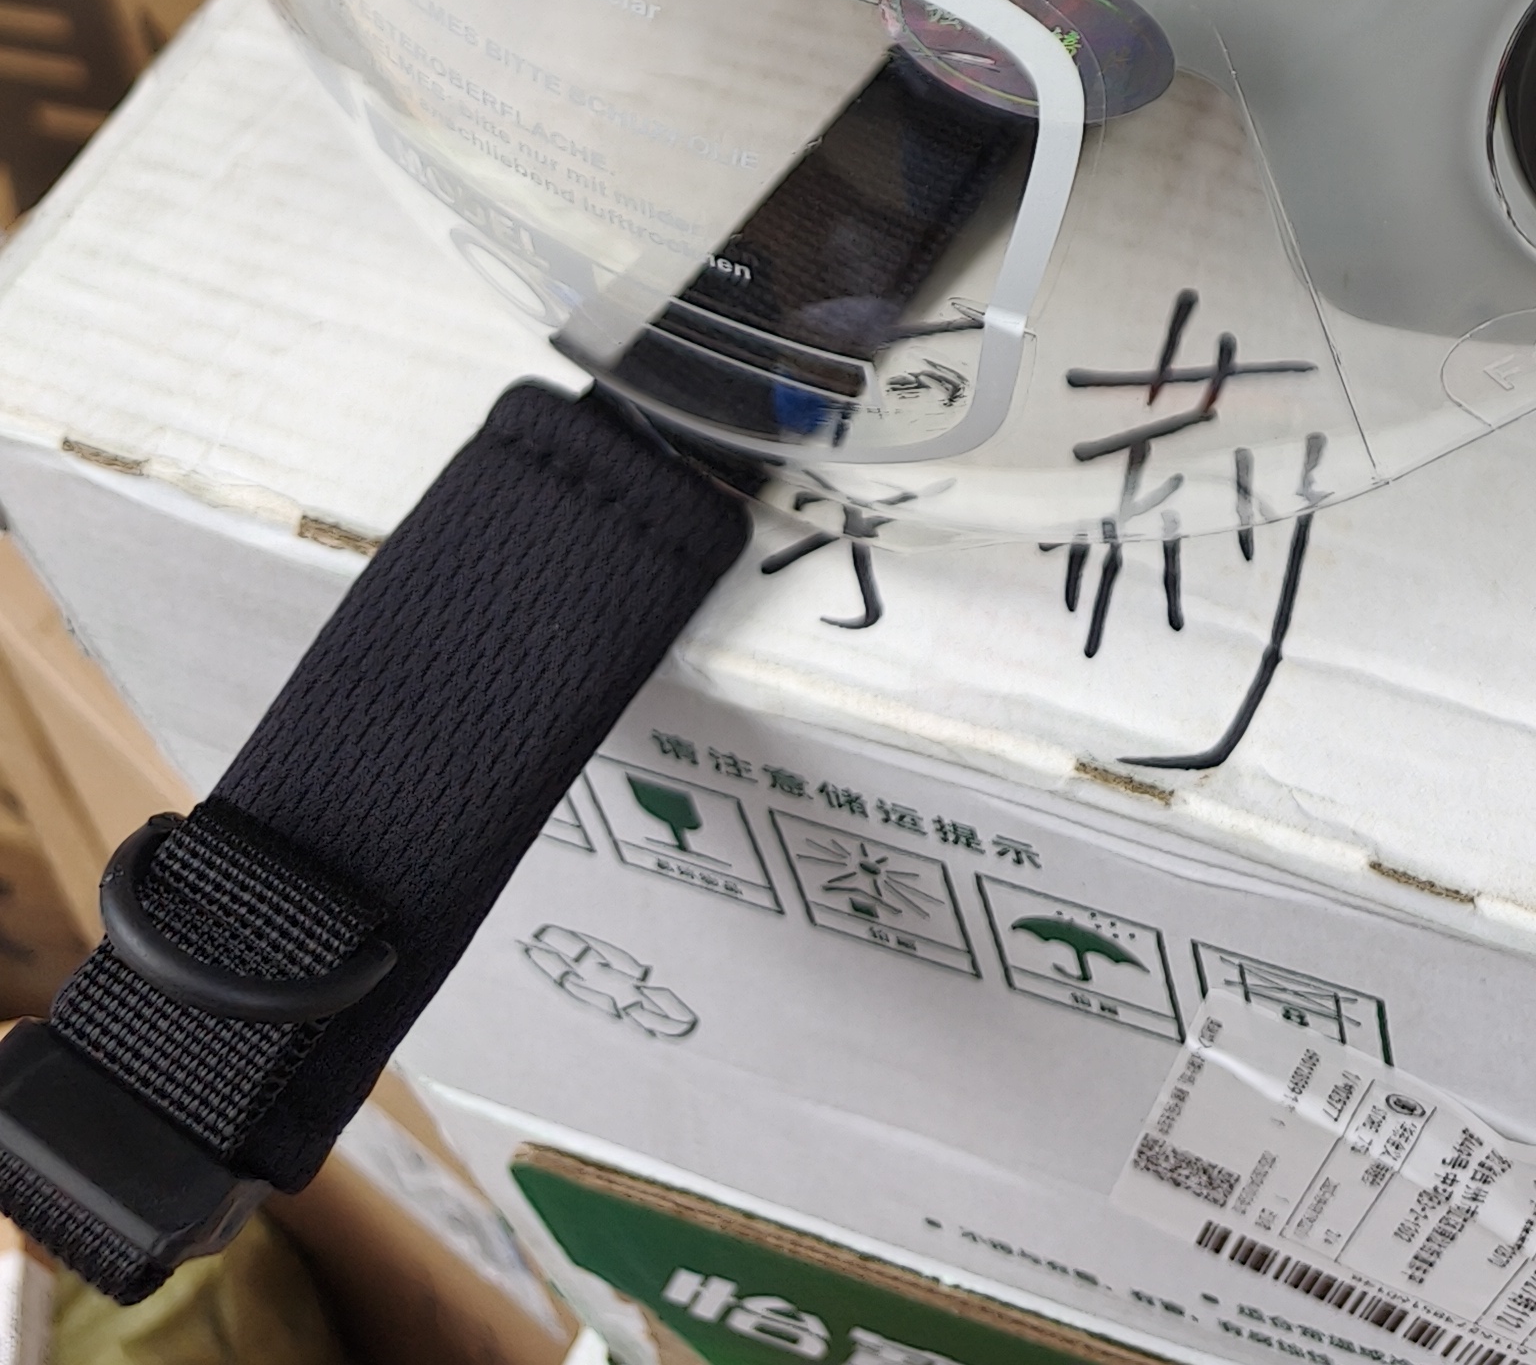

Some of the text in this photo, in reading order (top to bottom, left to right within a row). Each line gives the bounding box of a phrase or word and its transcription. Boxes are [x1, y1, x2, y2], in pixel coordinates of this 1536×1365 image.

[485, 37, 563, 97] BITTE
[566, 166, 607, 199] mit
[650, 727, 1044, 871] 请注意储运提示
